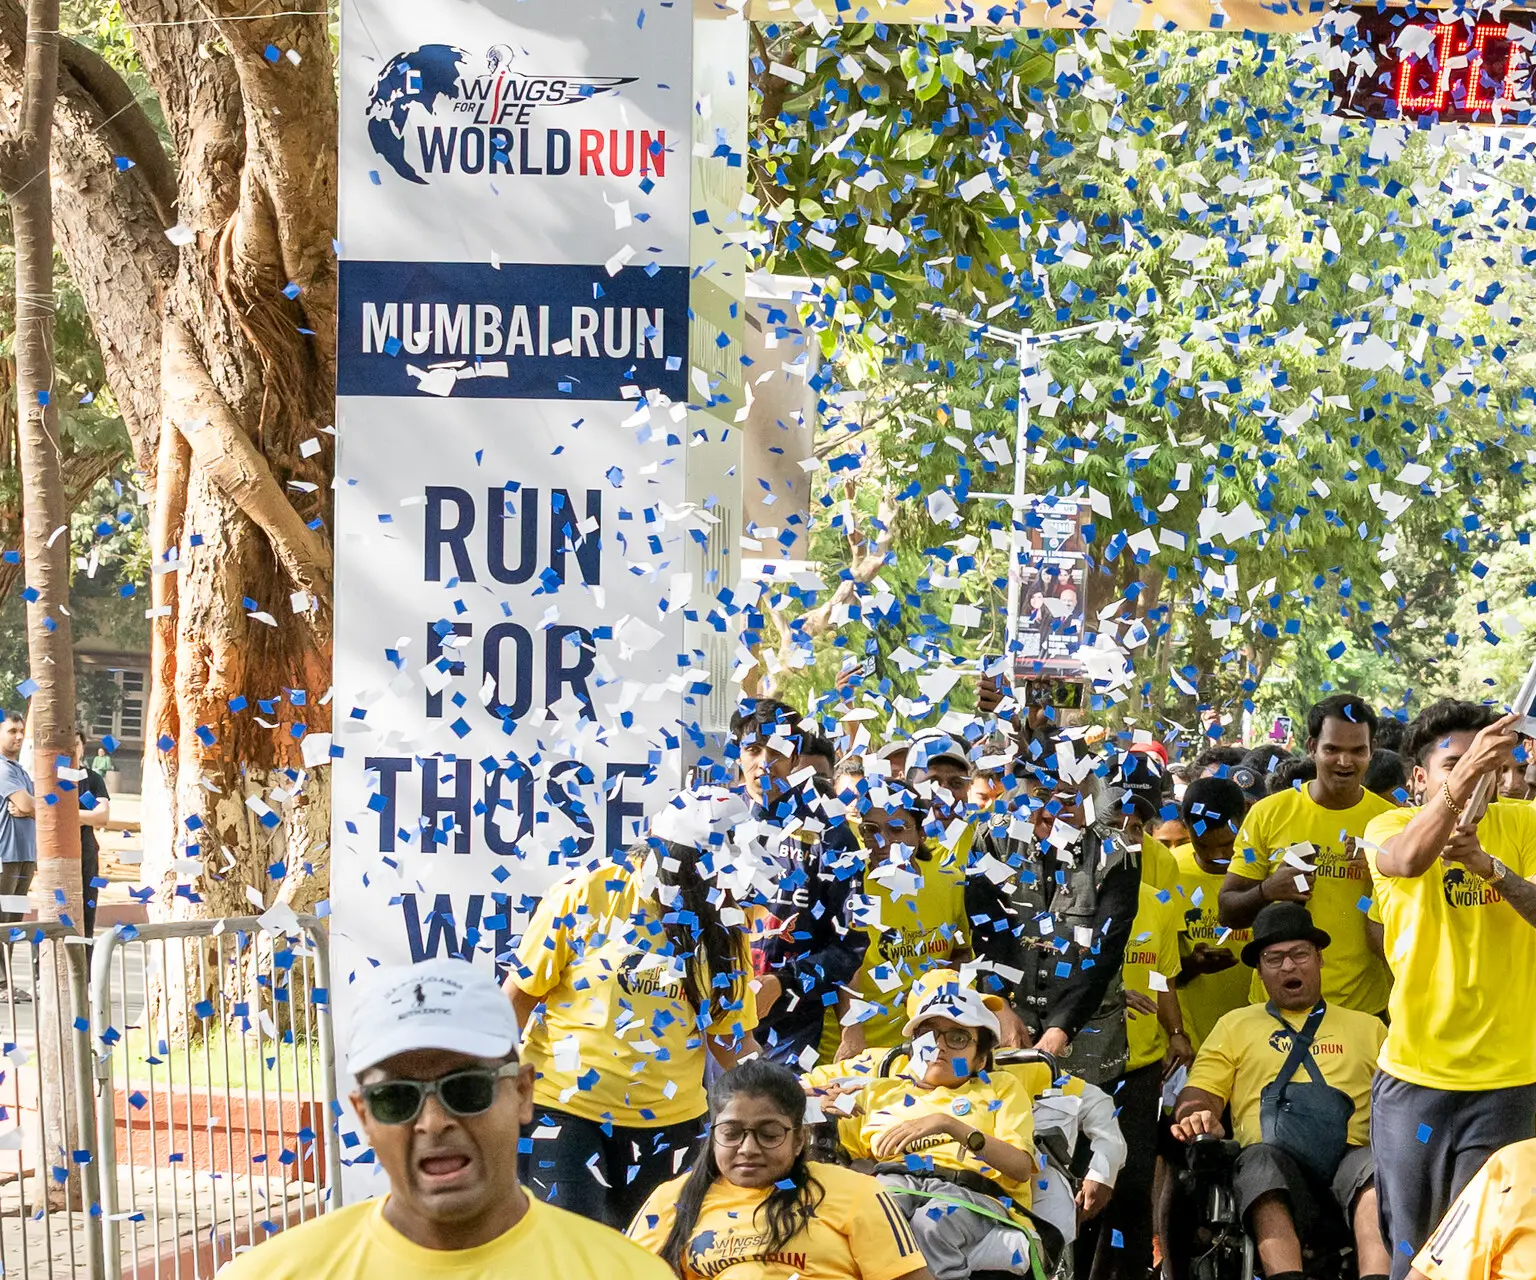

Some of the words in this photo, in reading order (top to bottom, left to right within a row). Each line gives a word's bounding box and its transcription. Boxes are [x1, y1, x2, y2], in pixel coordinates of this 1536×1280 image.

[460, 73, 569, 102] WINGS
[452, 102, 477, 113] FOR
[472, 102, 537, 125] LIFE
[416, 125, 572, 176] WORLD
[579, 128, 666, 178] RUN
[361, 301, 550, 357] MUMBAI
[570, 305, 665, 360] RUN
[423, 484, 603, 586] RUN
[424, 621, 598, 722] FOR
[363, 756, 653, 859] THOSE
[780, 844, 817, 867] BYBIT
[1314, 864, 1347, 879] ORLD
[1347, 866, 1362, 880] RU
[1455, 890, 1486, 907] WORL
[1485, 888, 1503, 905] RU
[1228, 928, 1249, 941] RUN
[928, 939, 949, 954] RUN
[1138, 951, 1157, 965] RUN
[1321, 1043, 1344, 1055] RUN
